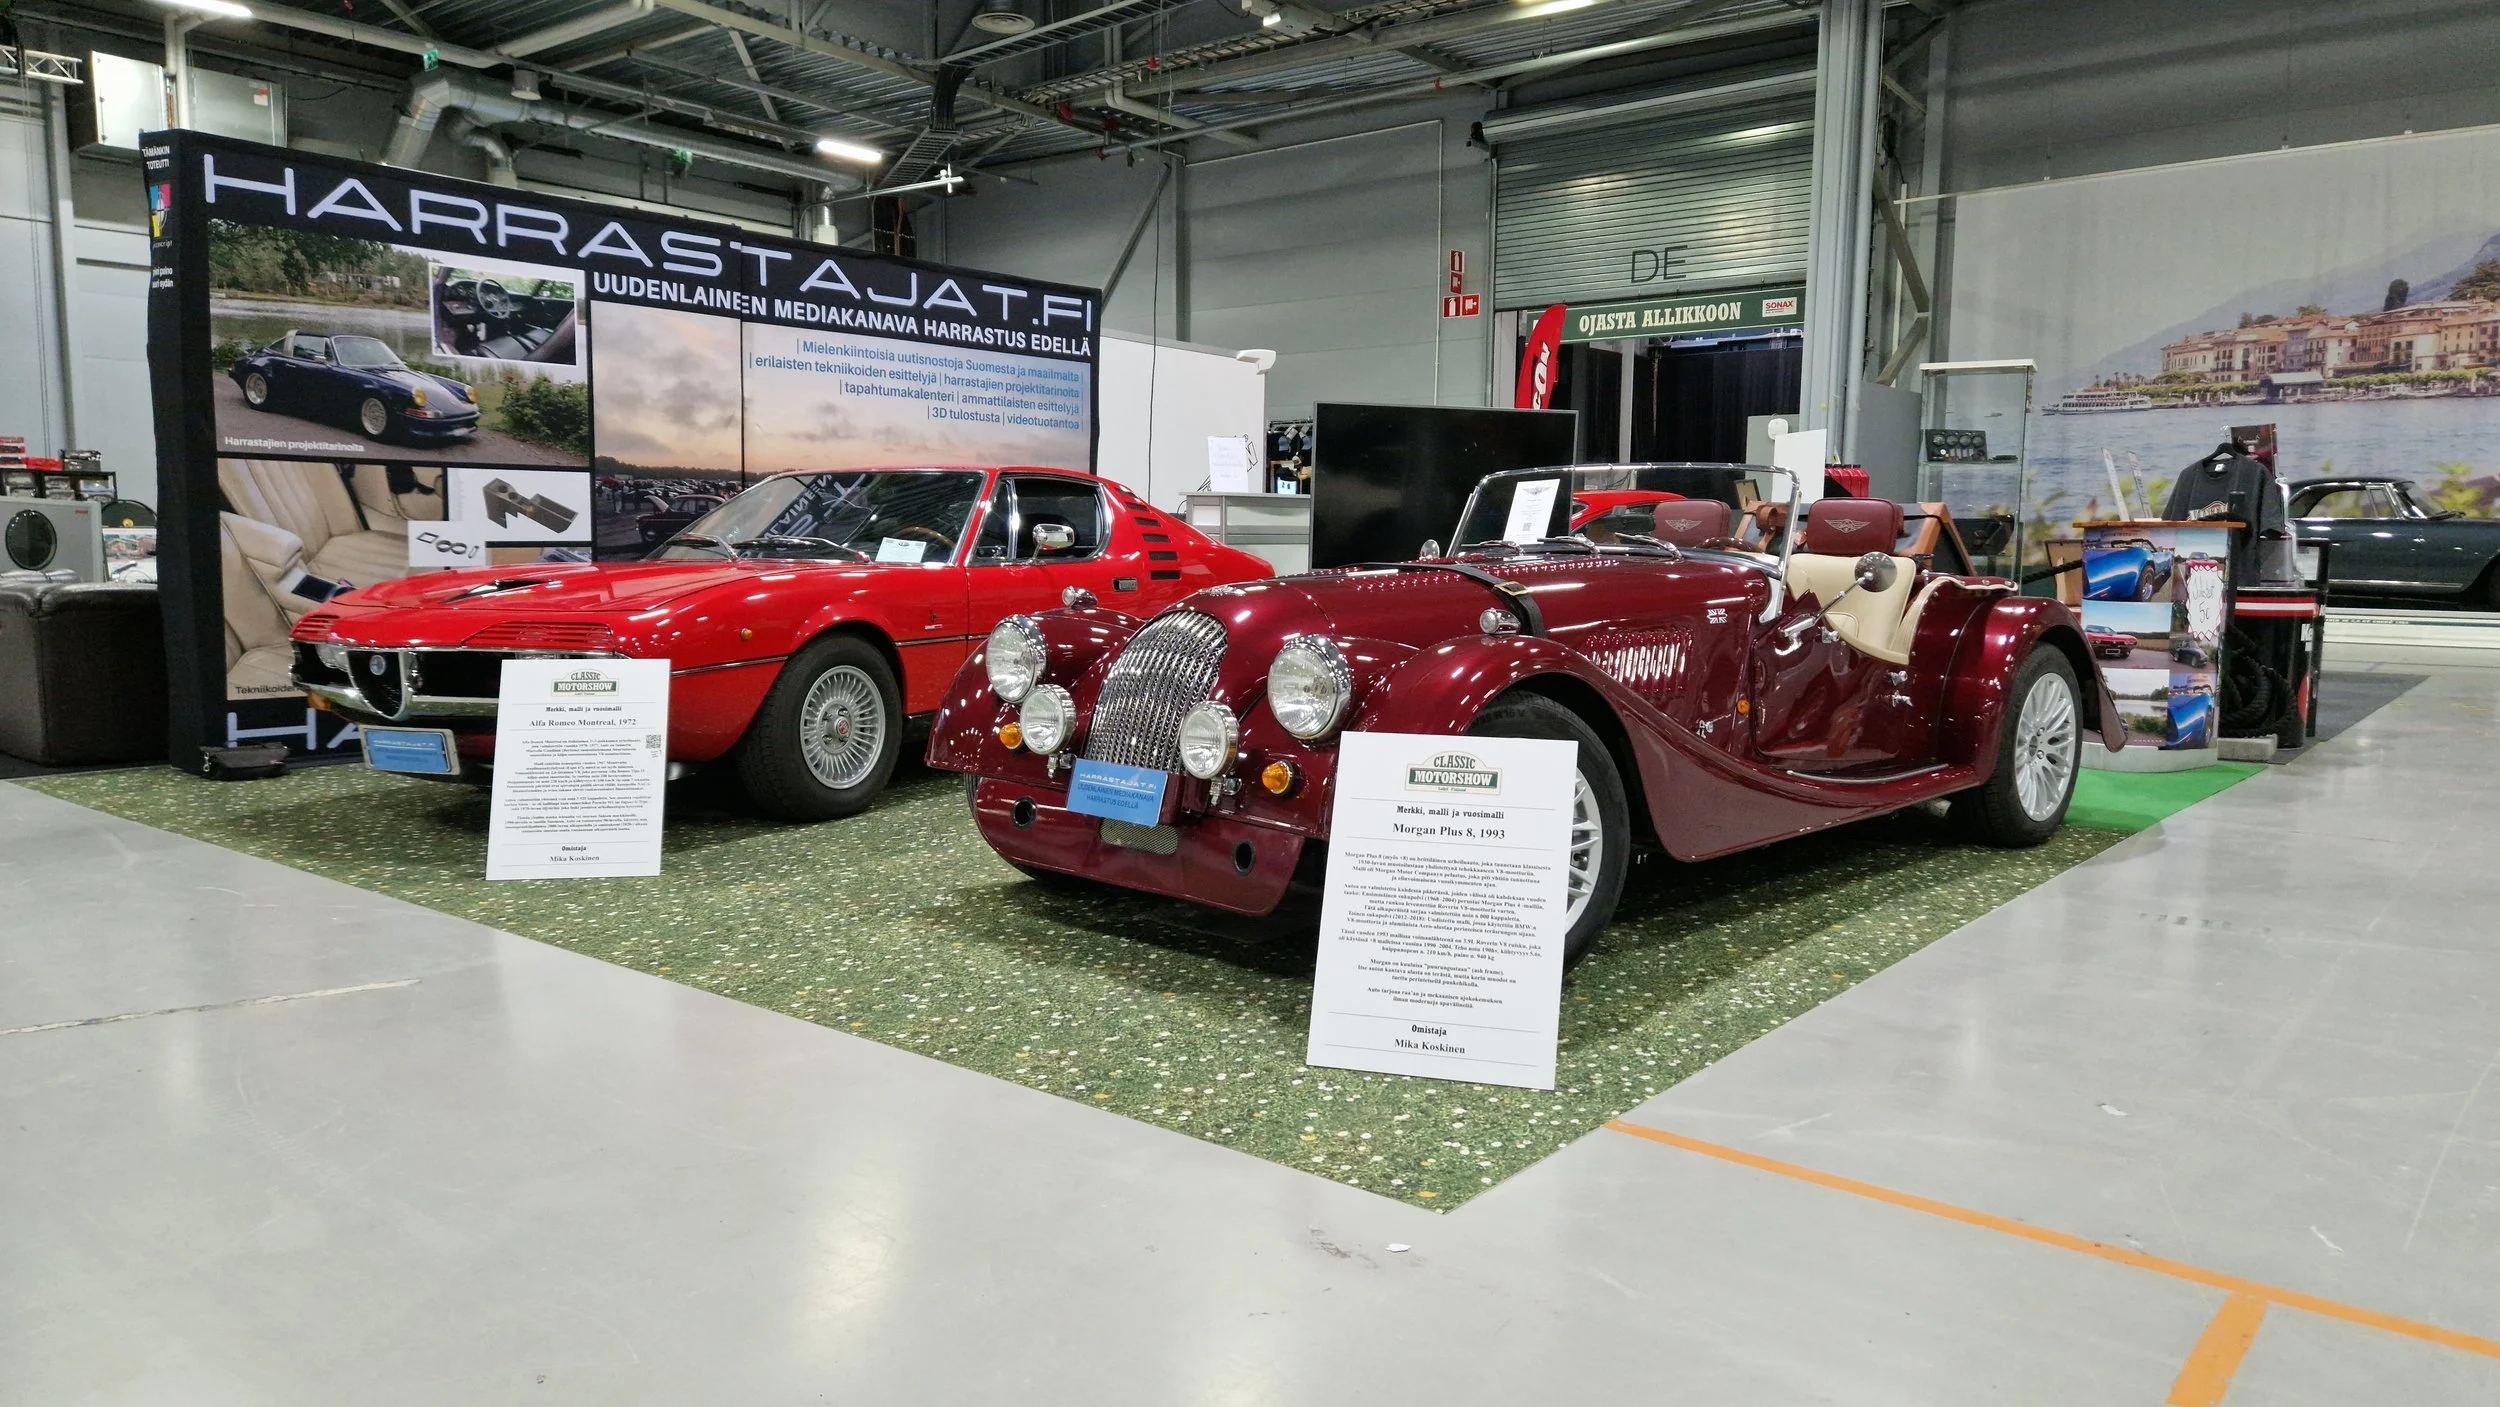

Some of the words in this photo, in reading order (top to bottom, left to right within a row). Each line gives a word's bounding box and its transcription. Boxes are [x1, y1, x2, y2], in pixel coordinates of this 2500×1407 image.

[142, 145, 170, 158] TÄMÄNKIN
[146, 158, 169, 170] TOTEUTTI
[203, 153, 1092, 332] HARRASTAJAT.FI
[1630, 244, 1688, 284] DE
[1765, 300, 1793, 309] SONAX
[593, 271, 766, 316] UUDENLAINEN
[774, 298, 918, 335] MEDIAKANAVA
[924, 318, 1026, 348] HARRASTUS
[1031, 333, 1092, 357] EDELLÄ
[1579, 311, 1637, 337] OJASTA
[1642, 301, 1742, 328] ALLIKKOON
[803, 340, 895, 361] Mielenkiintoisia
[897, 354, 963, 371] uutisnostoja
[966, 358, 1015, 375] Suomesta
[1017, 365, 1026, 378] ja
[1028, 367, 1079, 382] maailmalta
[755, 355, 812, 372] erilaisten
[815, 360, 887, 378] tekniikoiden
[889, 368, 936, 385] esittelyjä
[944, 372, 1003, 390] harrastajien
[1005, 381, 1080, 399] projektitarinoita
[845, 381, 955, 402] tapahtumakalenteri
[962, 393, 1035, 410] ammattilaisten
[1038, 400, 1080, 415] esittelyjä
[932, 407, 947, 418] 3D
[950, 408, 1000, 423] tulostusta
[1007, 414, 1080, 429] videotuotantoa
[224, 436, 287, 450] Harrastajien
[288, 440, 366, 452] projektitarinoita
[570, 671, 601, 681] CLASSIC
[557, 682, 613, 692] MOTORSHOW
[578, 719, 616, 727] Montreal,
[1433, 755, 1476, 770] CLASSIC
[1080, 773, 1157, 789] HARRASTAJAT.FI
[1414, 770, 1493, 786] MOTORSHOW
[1396, 806, 1425, 816] Merkki,
[1428, 808, 1449, 817] malli
[1452, 809, 1460, 818] ja
[1463, 810, 1505, 820] vuosimalli
[1393, 823, 1436, 836] Morgan
[1440, 826, 1463, 837] Plus
[1466, 827, 1476, 838] 8,
[1480, 829, 1505, 840] 1993
[1411, 1024, 1447, 1037] Omistaja
[1395, 1038, 1419, 1050] Mika
[1422, 1041, 1466, 1054] Koskinen
